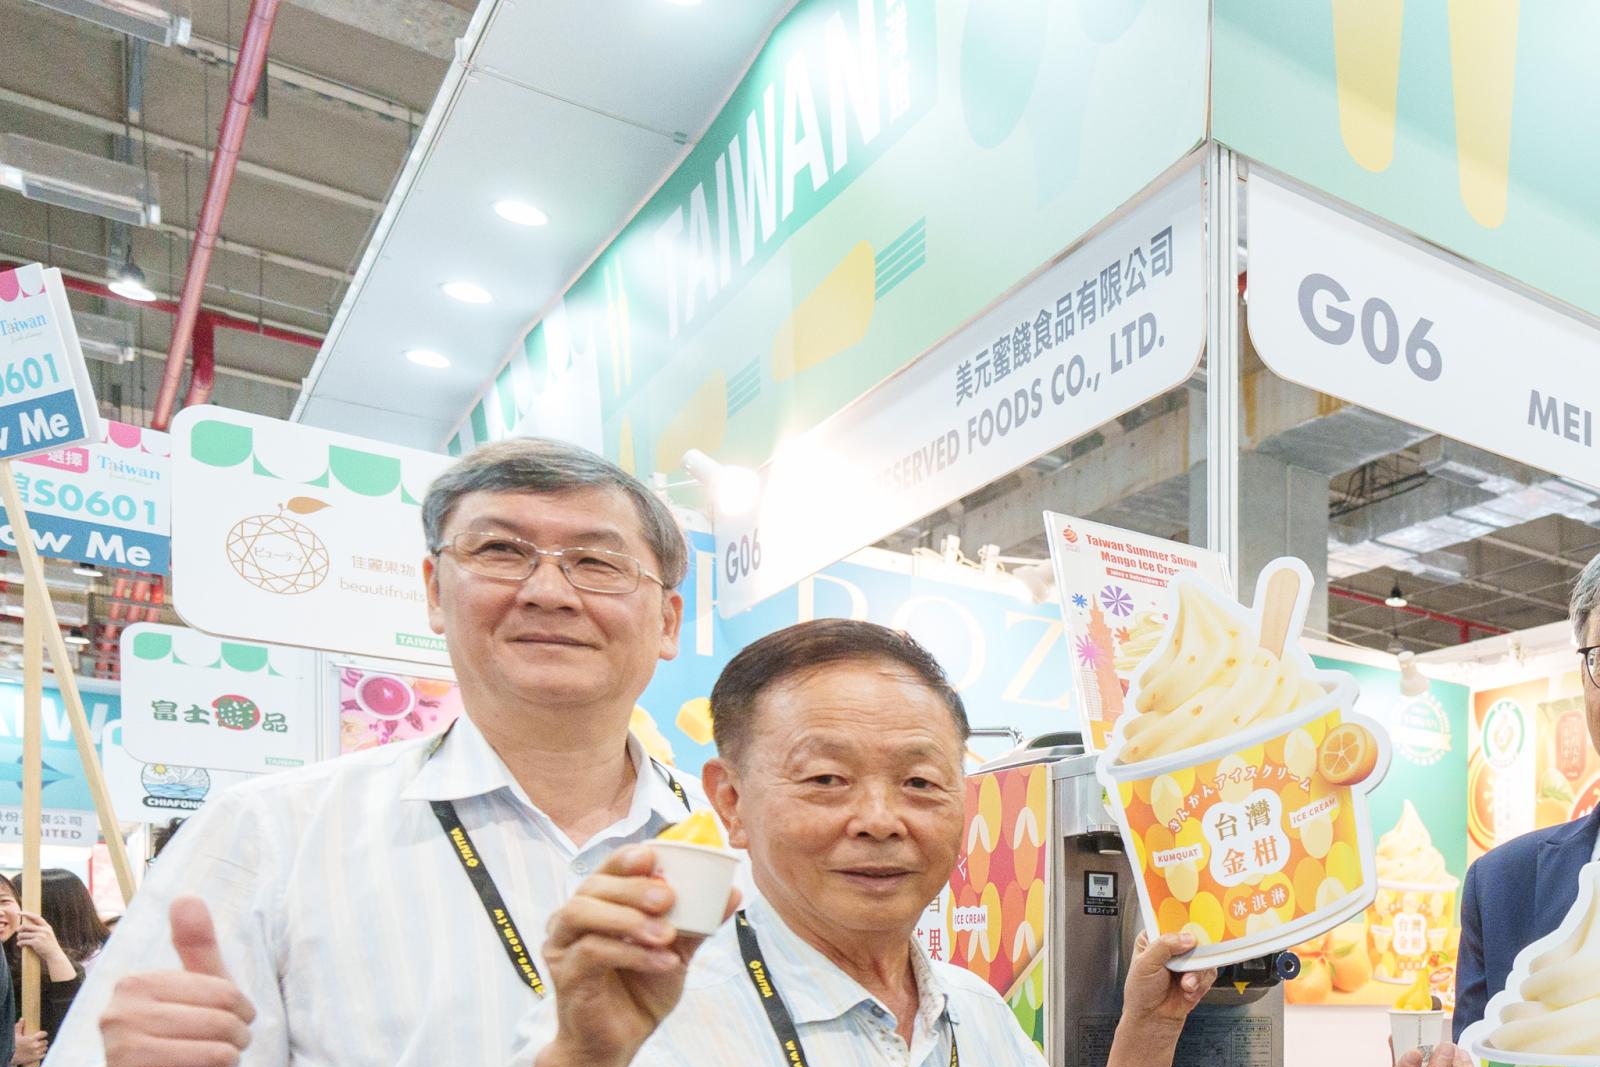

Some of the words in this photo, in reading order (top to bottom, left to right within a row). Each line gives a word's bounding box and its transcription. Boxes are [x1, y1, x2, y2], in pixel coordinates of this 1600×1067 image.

[1, 314, 47, 336] Taiwan
[956, 225, 1174, 407] 美元蜜餞食品有限公司
[1298, 272, 1443, 382] G06
[0, 353, 60, 397] 601
[968, 378, 1042, 455] FOODS
[1051, 354, 1100, 406] CO.,
[1110, 312, 1165, 375] LTD.
[19, 408, 70, 446] Me
[1527, 389, 1592, 448] MEI
[97, 455, 161, 481] Taiwan
[85, 530, 151, 567] Me
[725, 528, 762, 584] G06
[1086, 534, 1125, 552] Taiwan
[1126, 543, 1168, 562] Summer
[1171, 553, 1198, 569] Snow
[1101, 551, 1137, 568] Mango
[1139, 559, 1155, 572] Ice
[1157, 563, 1180, 576] Cre
[151, 697, 289, 734] 富士鮮品
[1214, 798, 1272, 842] 台灣
[1292, 811, 1308, 824] ICE
[1309, 798, 1337, 818] CREAM
[14, 827, 82, 840] LITED
[1157, 848, 1198, 863] KUMQUAT
[1222, 834, 1280, 878] 金柑
[954, 913, 964, 925] ICE
[965, 913, 986, 924] CREAM
[1232, 887, 1287, 917] 冰淇淋
